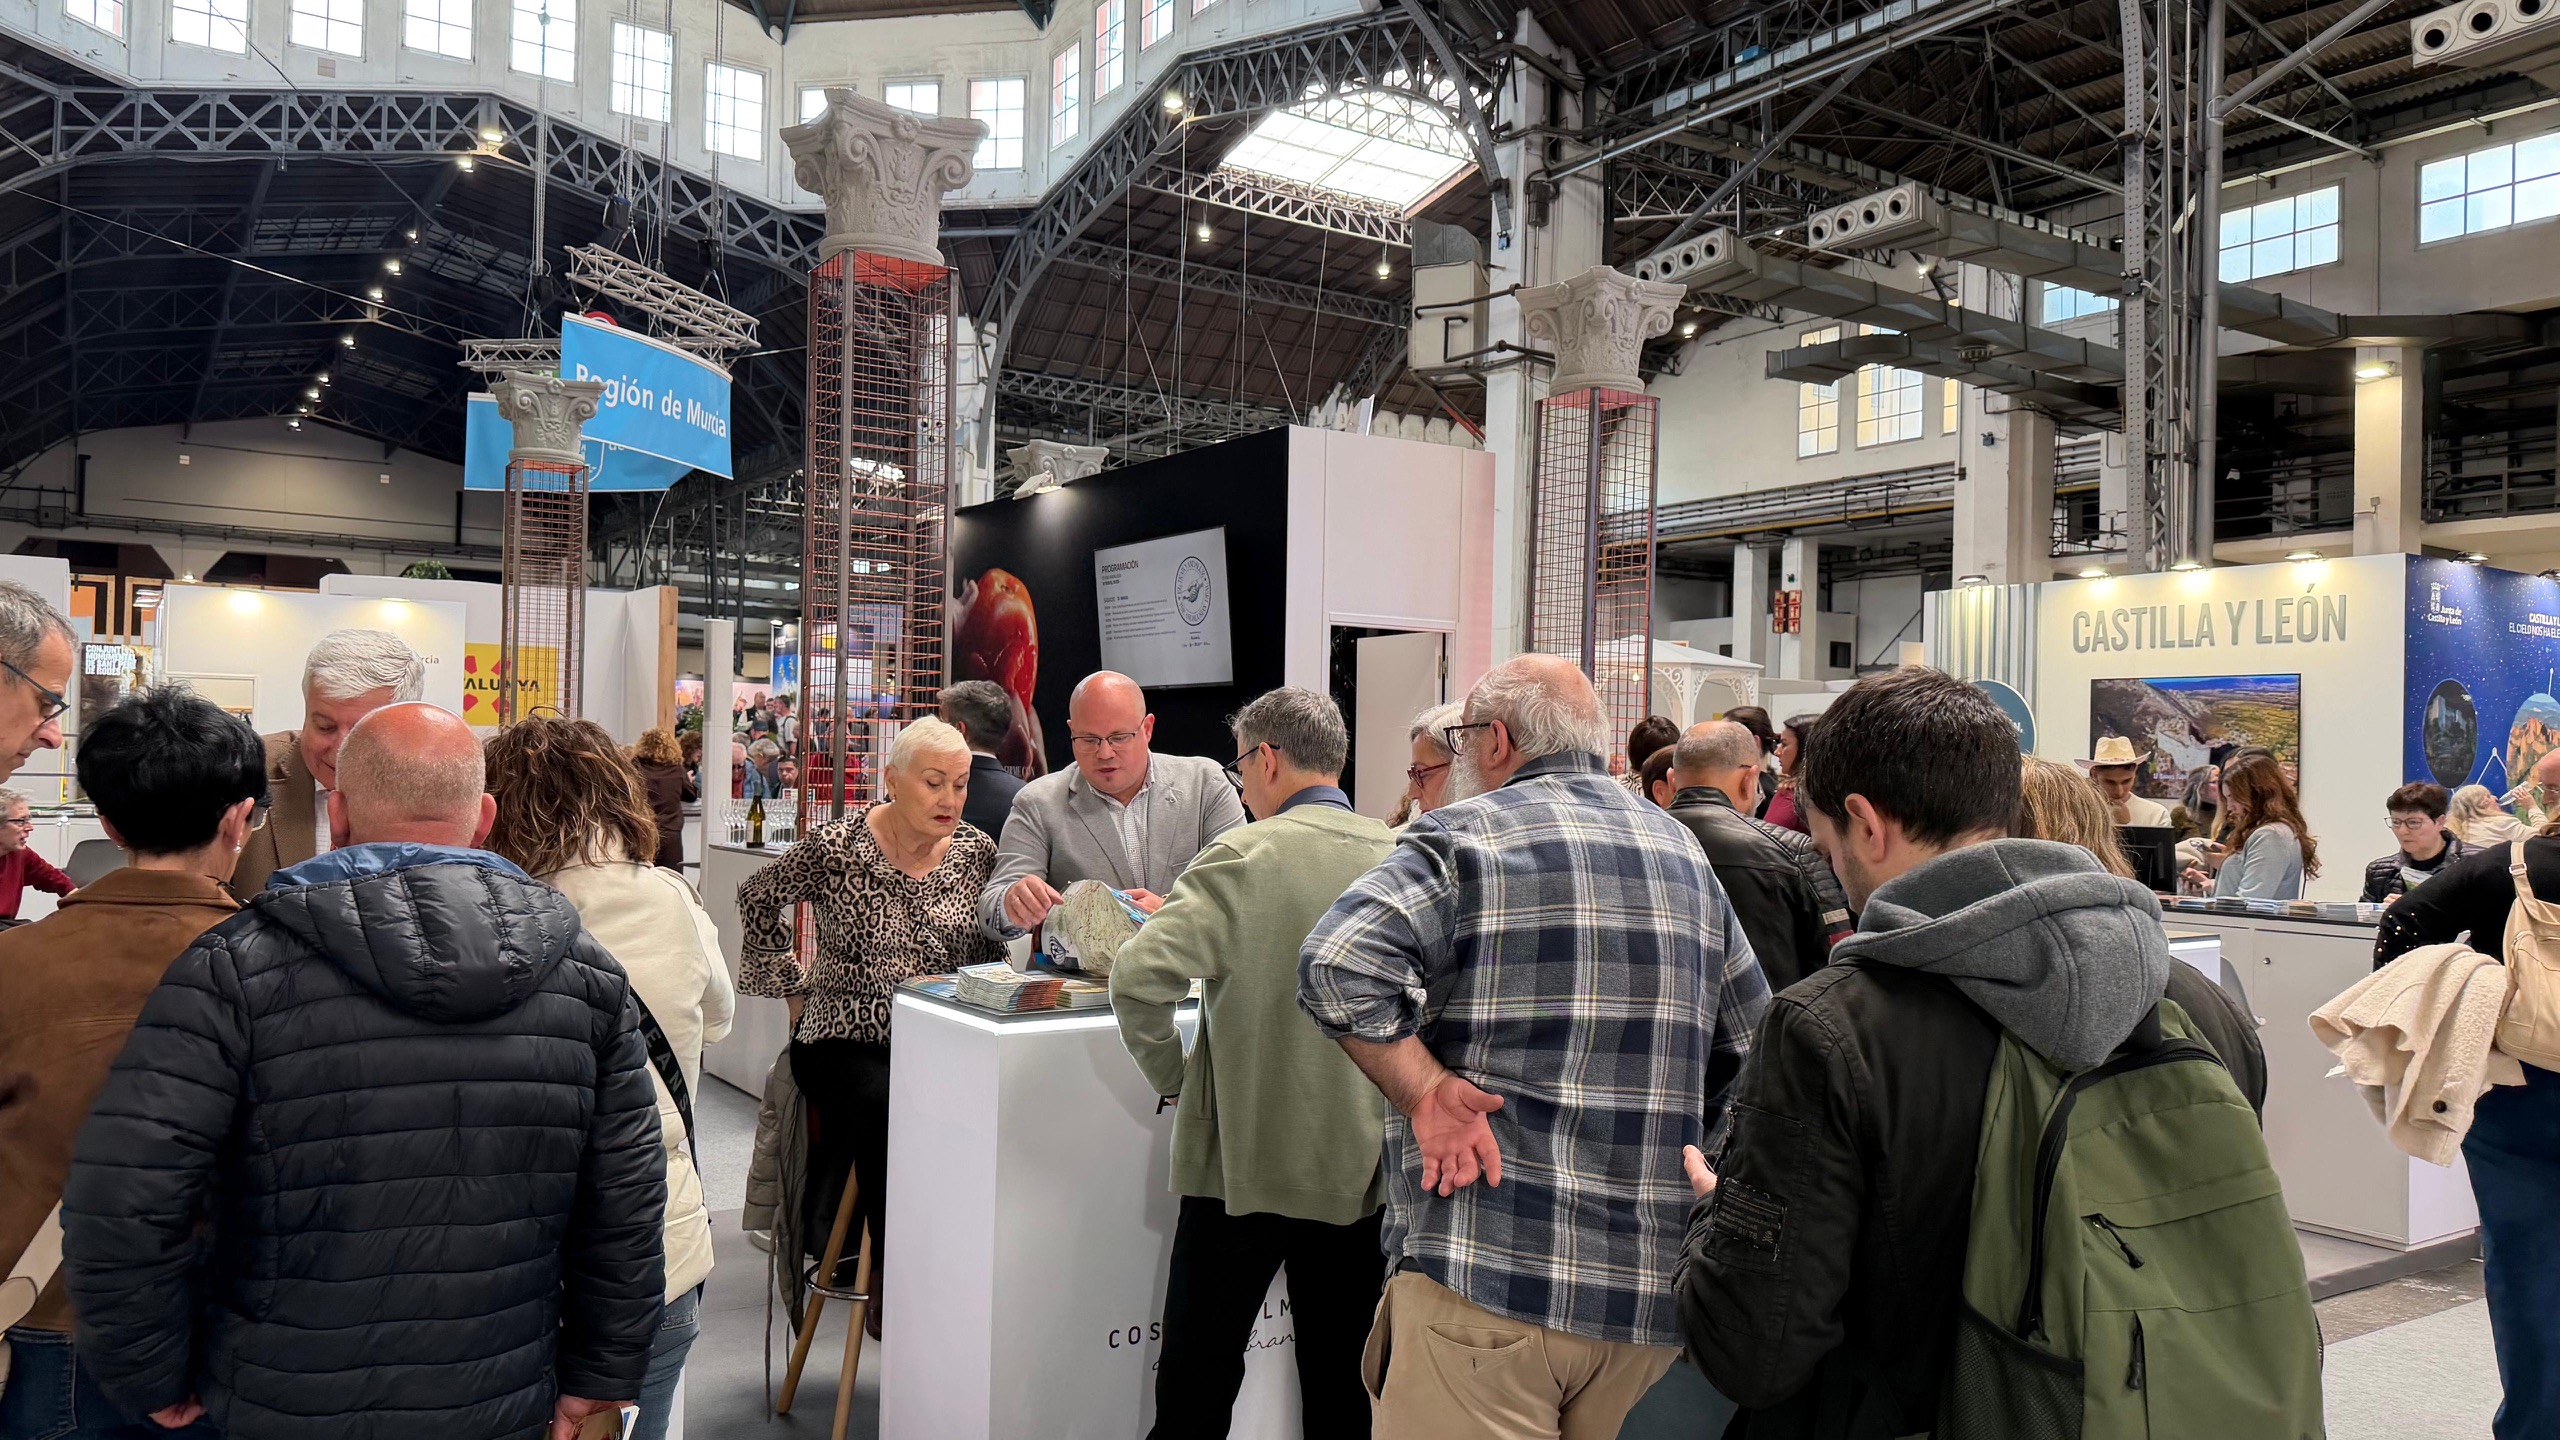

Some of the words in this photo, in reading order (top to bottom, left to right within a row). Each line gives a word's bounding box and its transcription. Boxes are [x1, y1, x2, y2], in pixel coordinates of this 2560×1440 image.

[661, 389, 682, 420] de
[686, 398, 727, 439] Murcia
[1101, 560, 1139, 574] PROGRAMACIÓN
[2441, 605, 2455, 615] Junta
[2455, 606, 2462, 616] de
[2073, 602, 2216, 654] CASTILLA
[2225, 600, 2247, 646] Y
[2255, 583, 2348, 645] LEÓN
[2427, 613, 2446, 623] Castilla
[2445, 616, 2450, 626] y
[2449, 615, 2462, 625] León
[2529, 612, 2553, 626] CASTILLA
[2509, 622, 2516, 633] EL
[2516, 623, 2532, 635] CIELO
[2531, 625, 2543, 637] NOS
[2543, 627, 2551, 638] HA
[85, 645, 121, 654] CONJUNT
[85, 660, 96, 668] DE
[97, 660, 116, 668] SANT
[421, 655, 440, 664] rcia
[464, 677, 541, 692] ALUYA
[1108, 1321, 1161, 1349] COS
